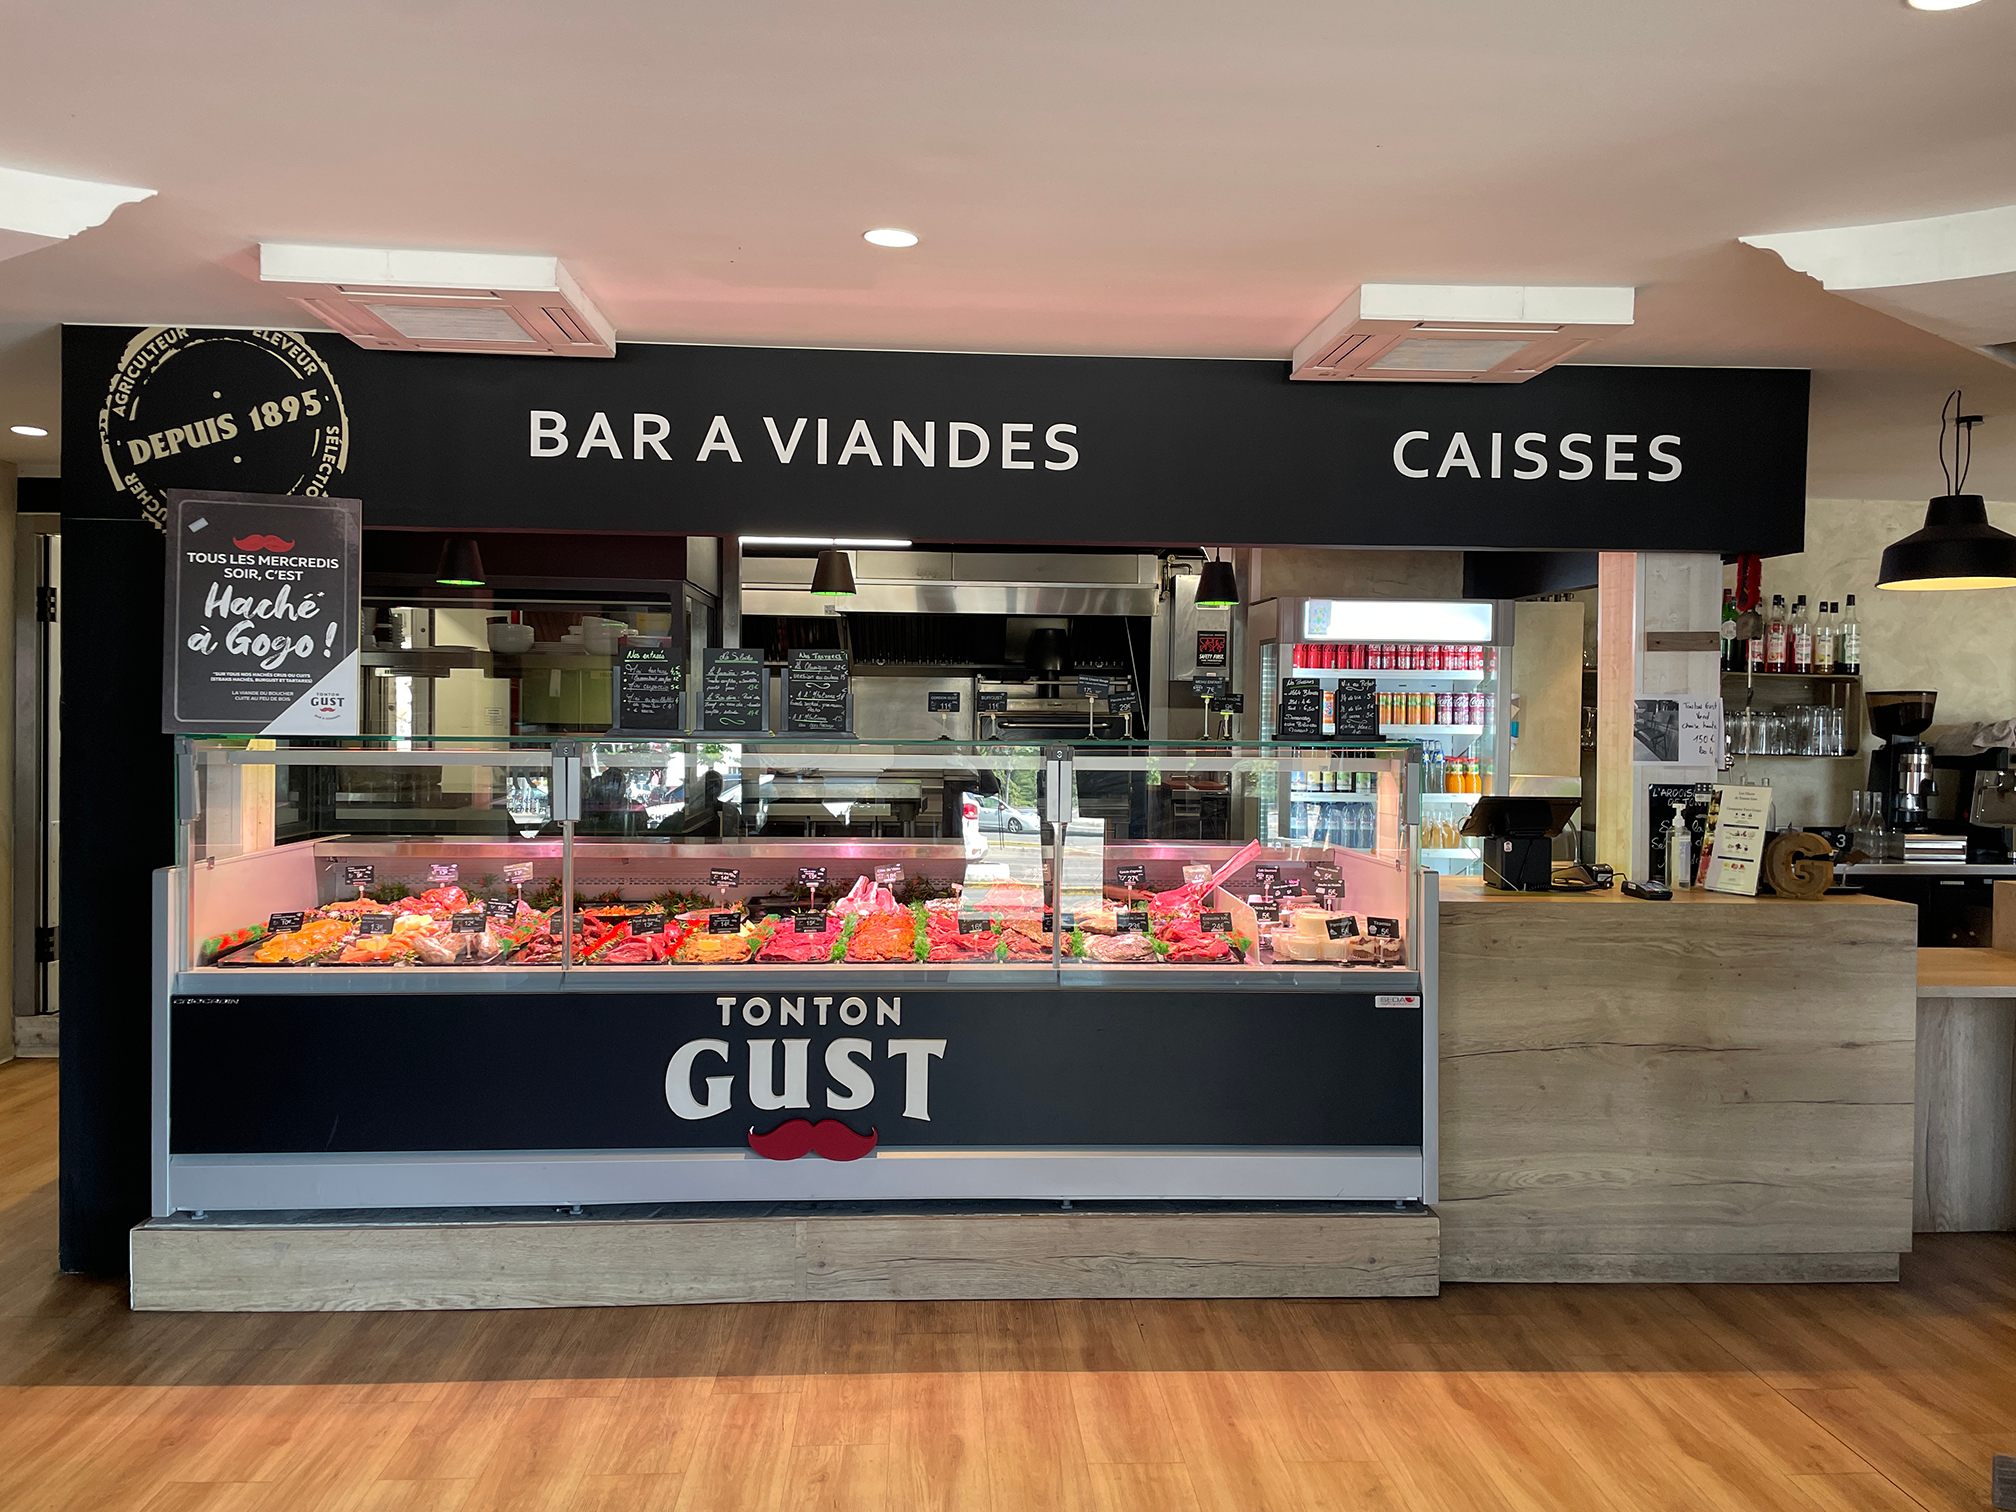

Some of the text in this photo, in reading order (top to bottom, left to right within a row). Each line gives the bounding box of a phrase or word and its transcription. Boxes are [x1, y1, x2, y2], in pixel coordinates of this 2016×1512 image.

[112, 328, 189, 417] AGRICULTEUR
[127, 389, 322, 465] DEPUIS 1895
[529, 410, 1080, 471] BAR A VIANDES
[304, 425, 340, 498] SELECTIO
[1393, 430, 1683, 482] CAISSES
[124, 472, 168, 521] UCHER
[187, 552, 339, 569] TOUS LES MERCREDIS
[224, 568, 303, 581] SOIR, C'EST
[187, 625, 218, 655] à
[226, 620, 314, 670] Gogo
[310, 697, 345, 707] GUST
[1693, 735, 1708, 744] 150
[1652, 788, 1695, 798] L'ARDOIS
[1766, 832, 1834, 899] G
[1836, 834, 1846, 848] 3
[716, 997, 901, 1026] TONTON
[665, 1037, 948, 1121] GUST
